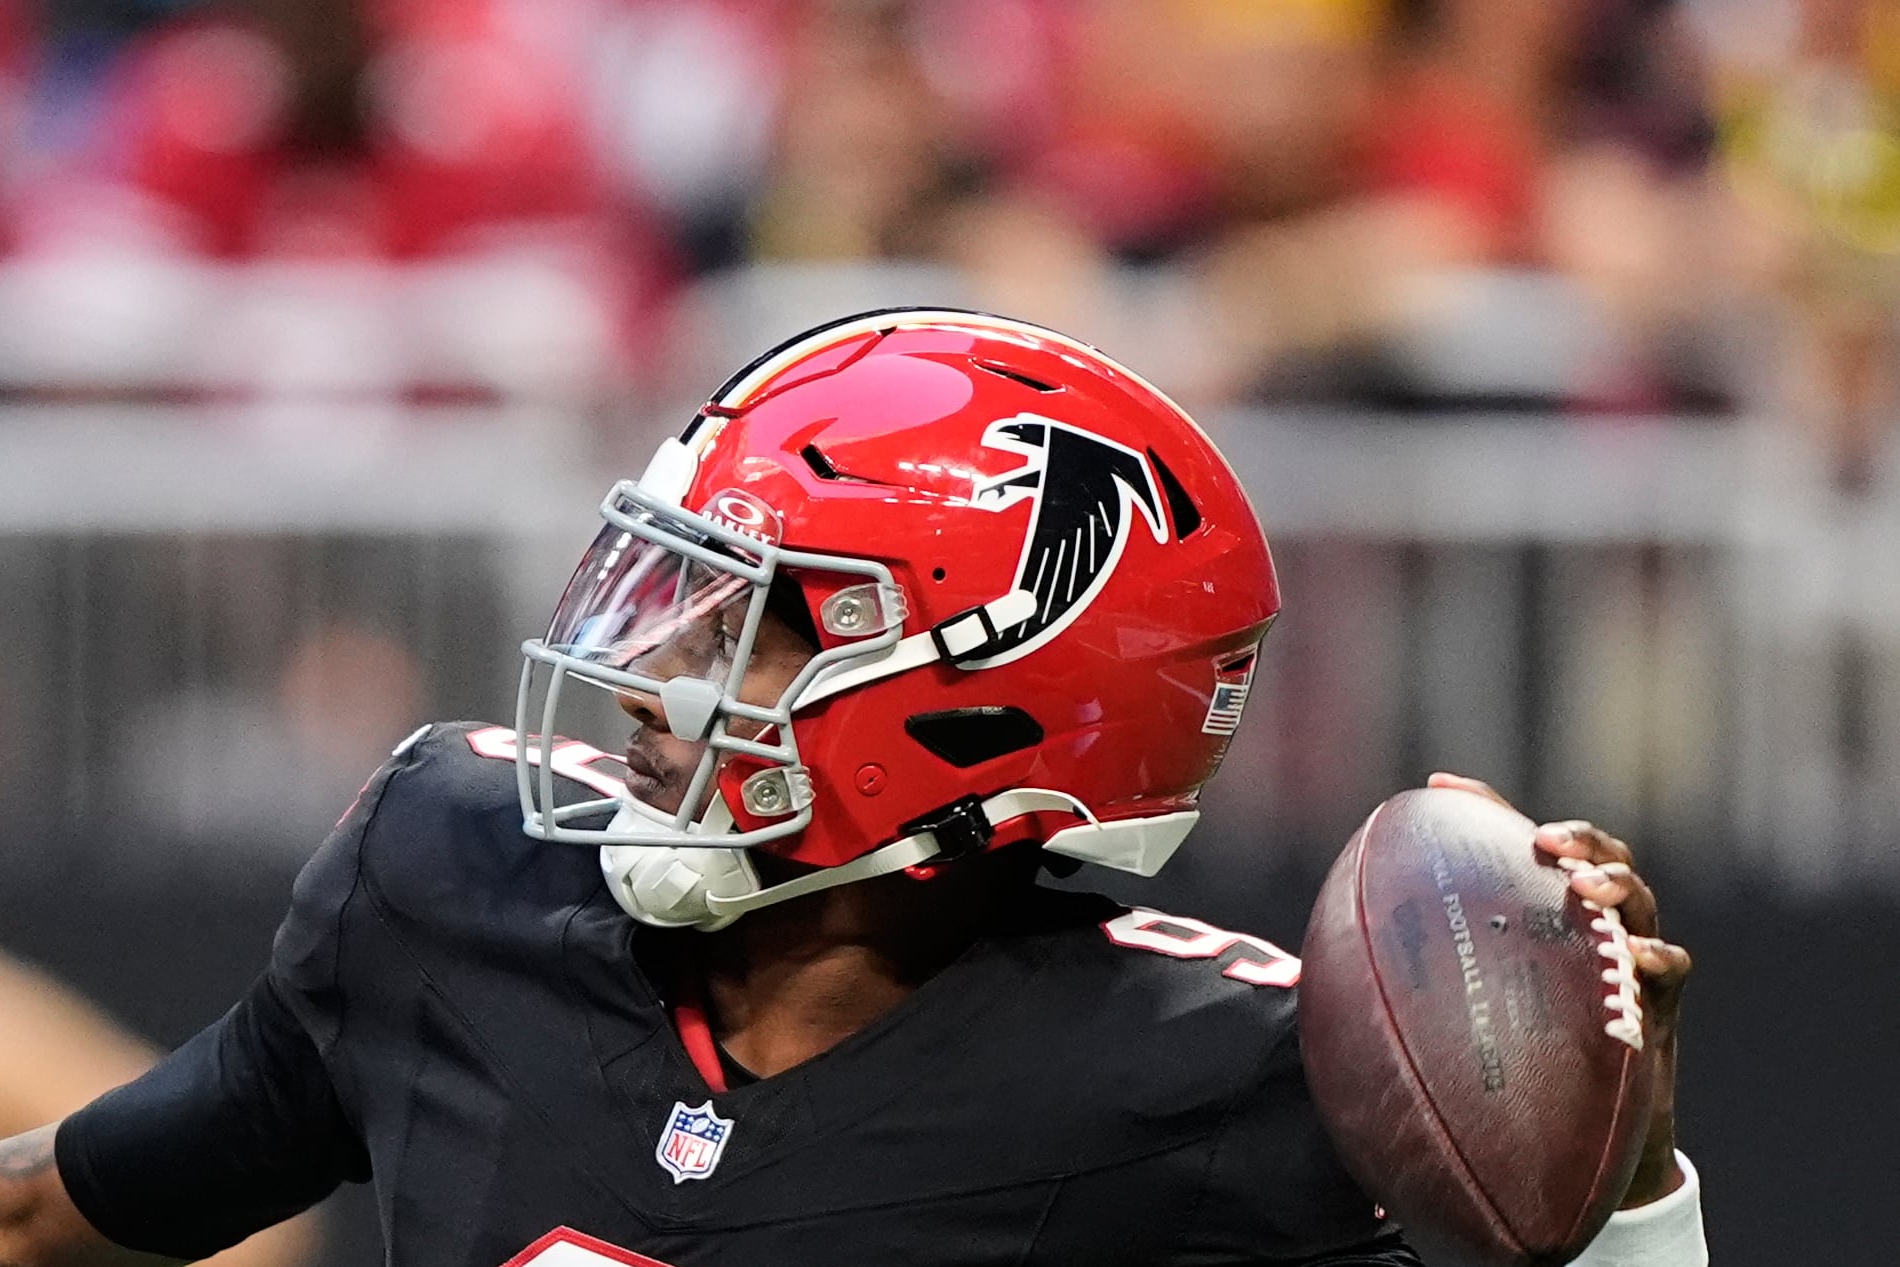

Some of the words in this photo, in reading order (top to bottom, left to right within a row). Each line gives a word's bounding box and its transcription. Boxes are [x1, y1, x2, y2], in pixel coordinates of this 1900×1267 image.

[702, 509, 773, 545] OAKLEY
[1099, 905, 1303, 989] 9
[1442, 892, 1483, 996] FOOTBALL
[666, 1132, 709, 1169] NFL
